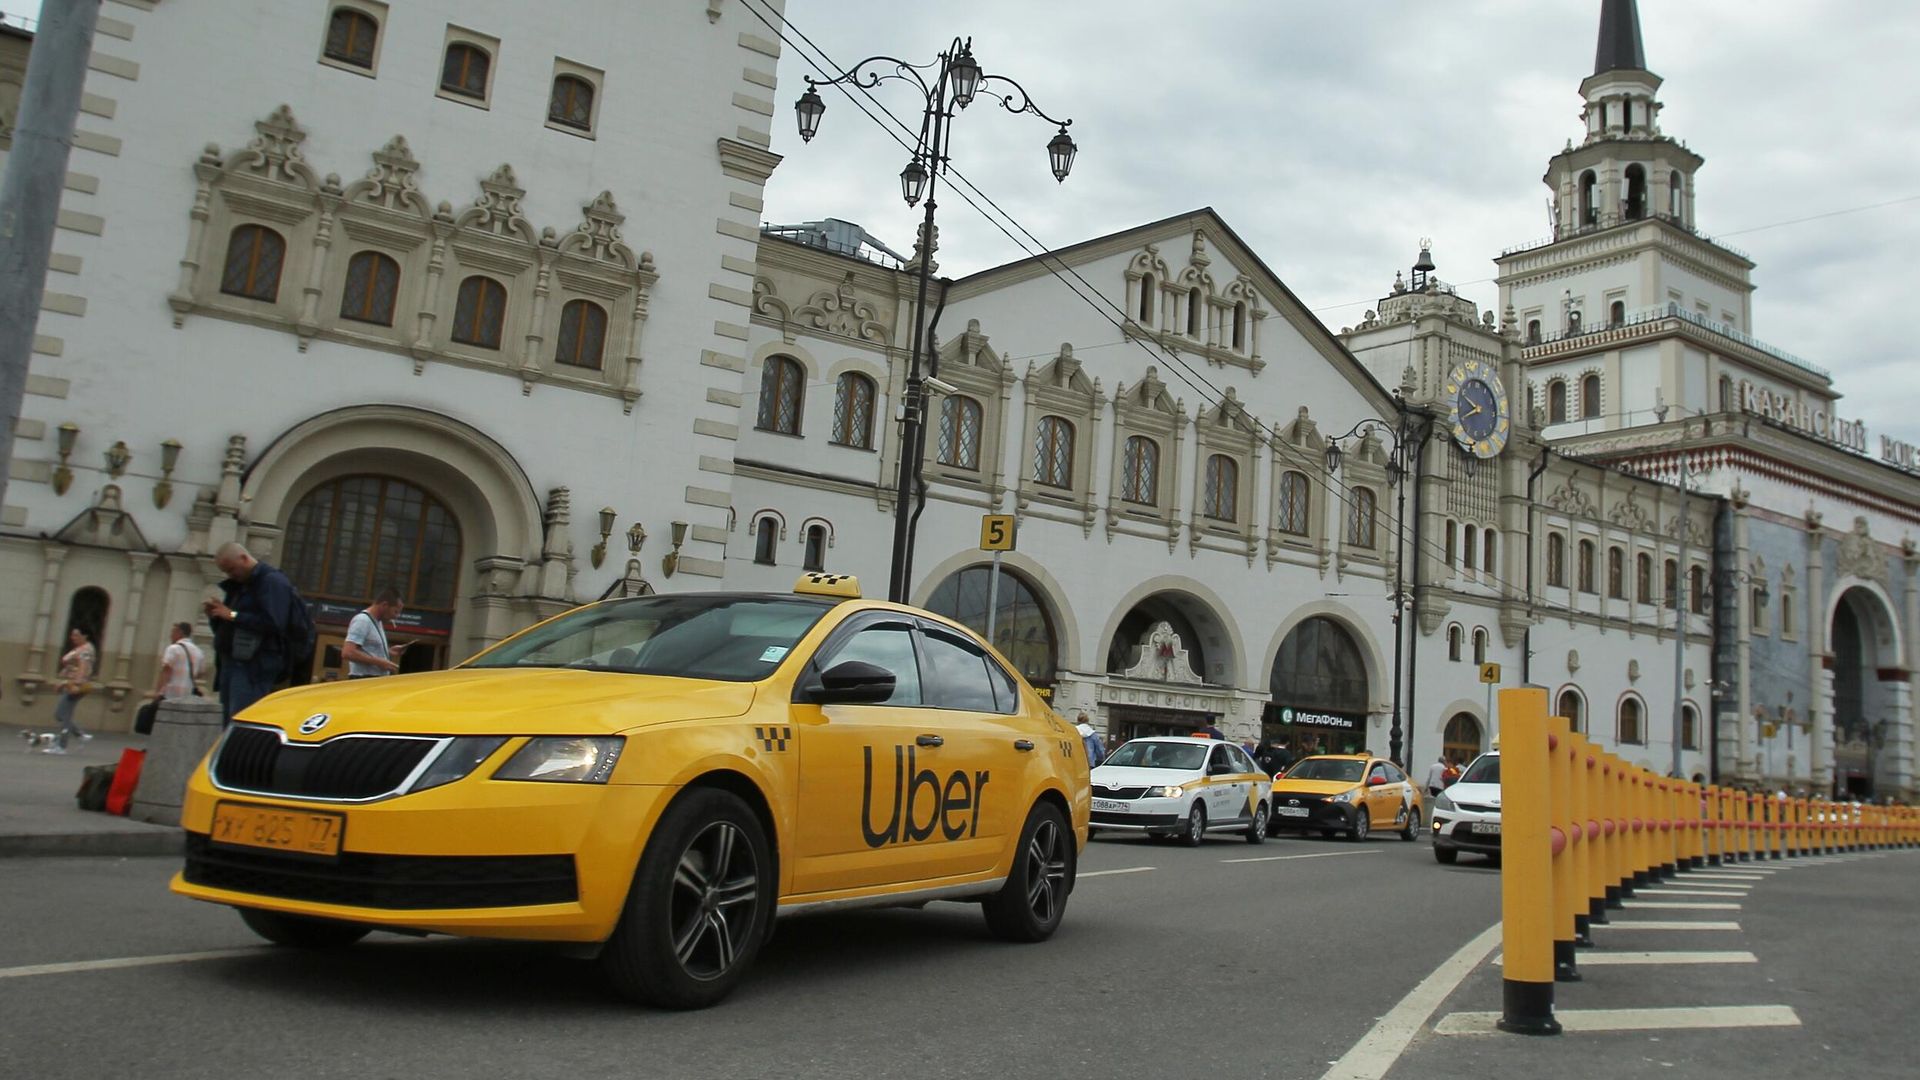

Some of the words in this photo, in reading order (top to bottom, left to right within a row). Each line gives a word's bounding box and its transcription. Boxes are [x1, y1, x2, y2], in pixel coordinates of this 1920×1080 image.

[1743, 381, 1867, 452] КАЗАНСКИЙ
[989, 520, 1004, 545] 5
[1484, 666, 1494, 680] 4
[861, 744, 990, 849] Uber
